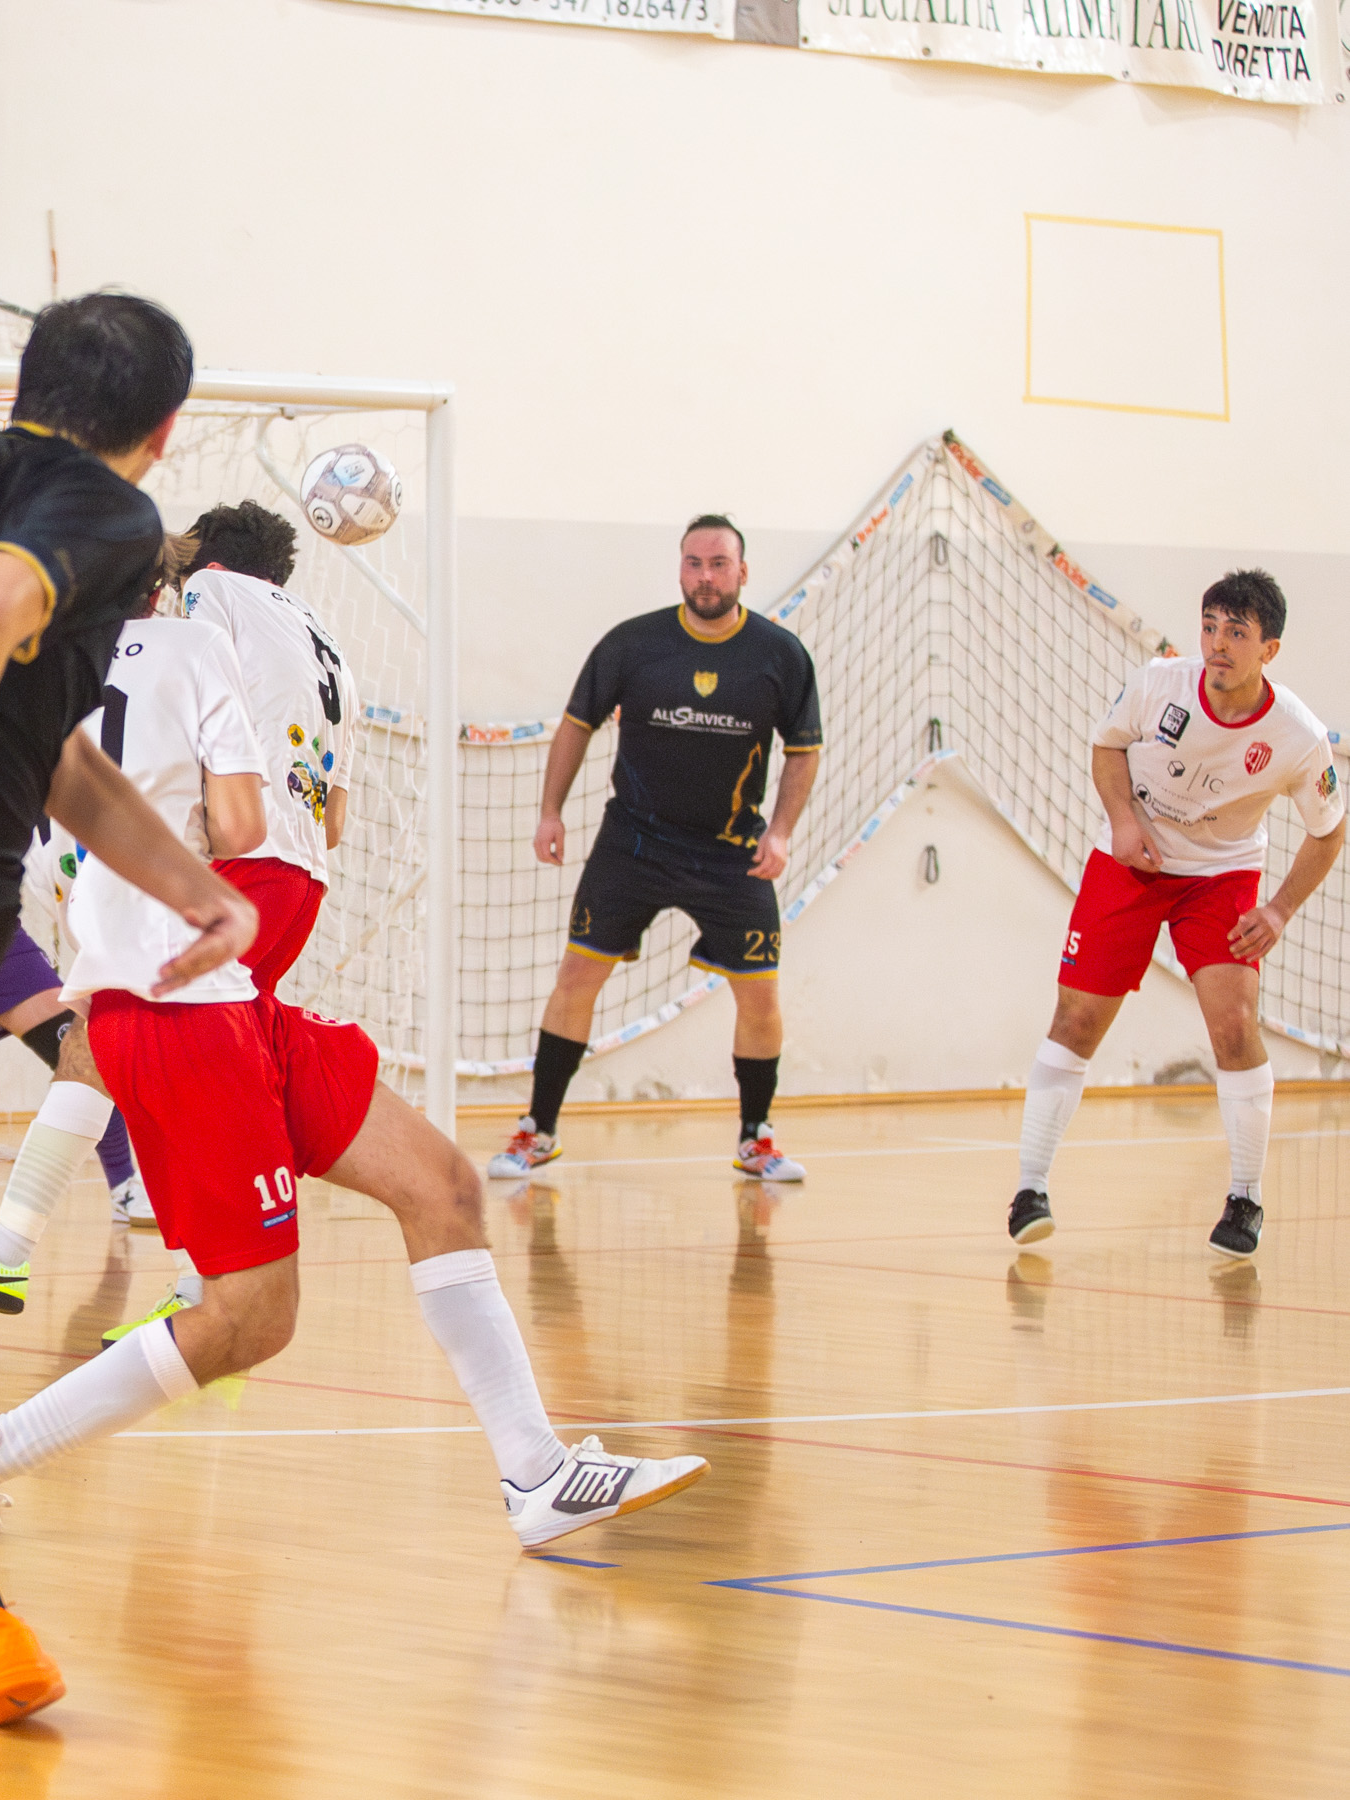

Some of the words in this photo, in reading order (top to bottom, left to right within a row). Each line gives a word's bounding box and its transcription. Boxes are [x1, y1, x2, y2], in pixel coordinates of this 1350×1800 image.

[1217, 0, 1306, 39] VENDITA
[1212, 39, 1311, 81] DIRETTA
[743, 930, 780, 962] 23
[253, 1165, 293, 1212] 10
